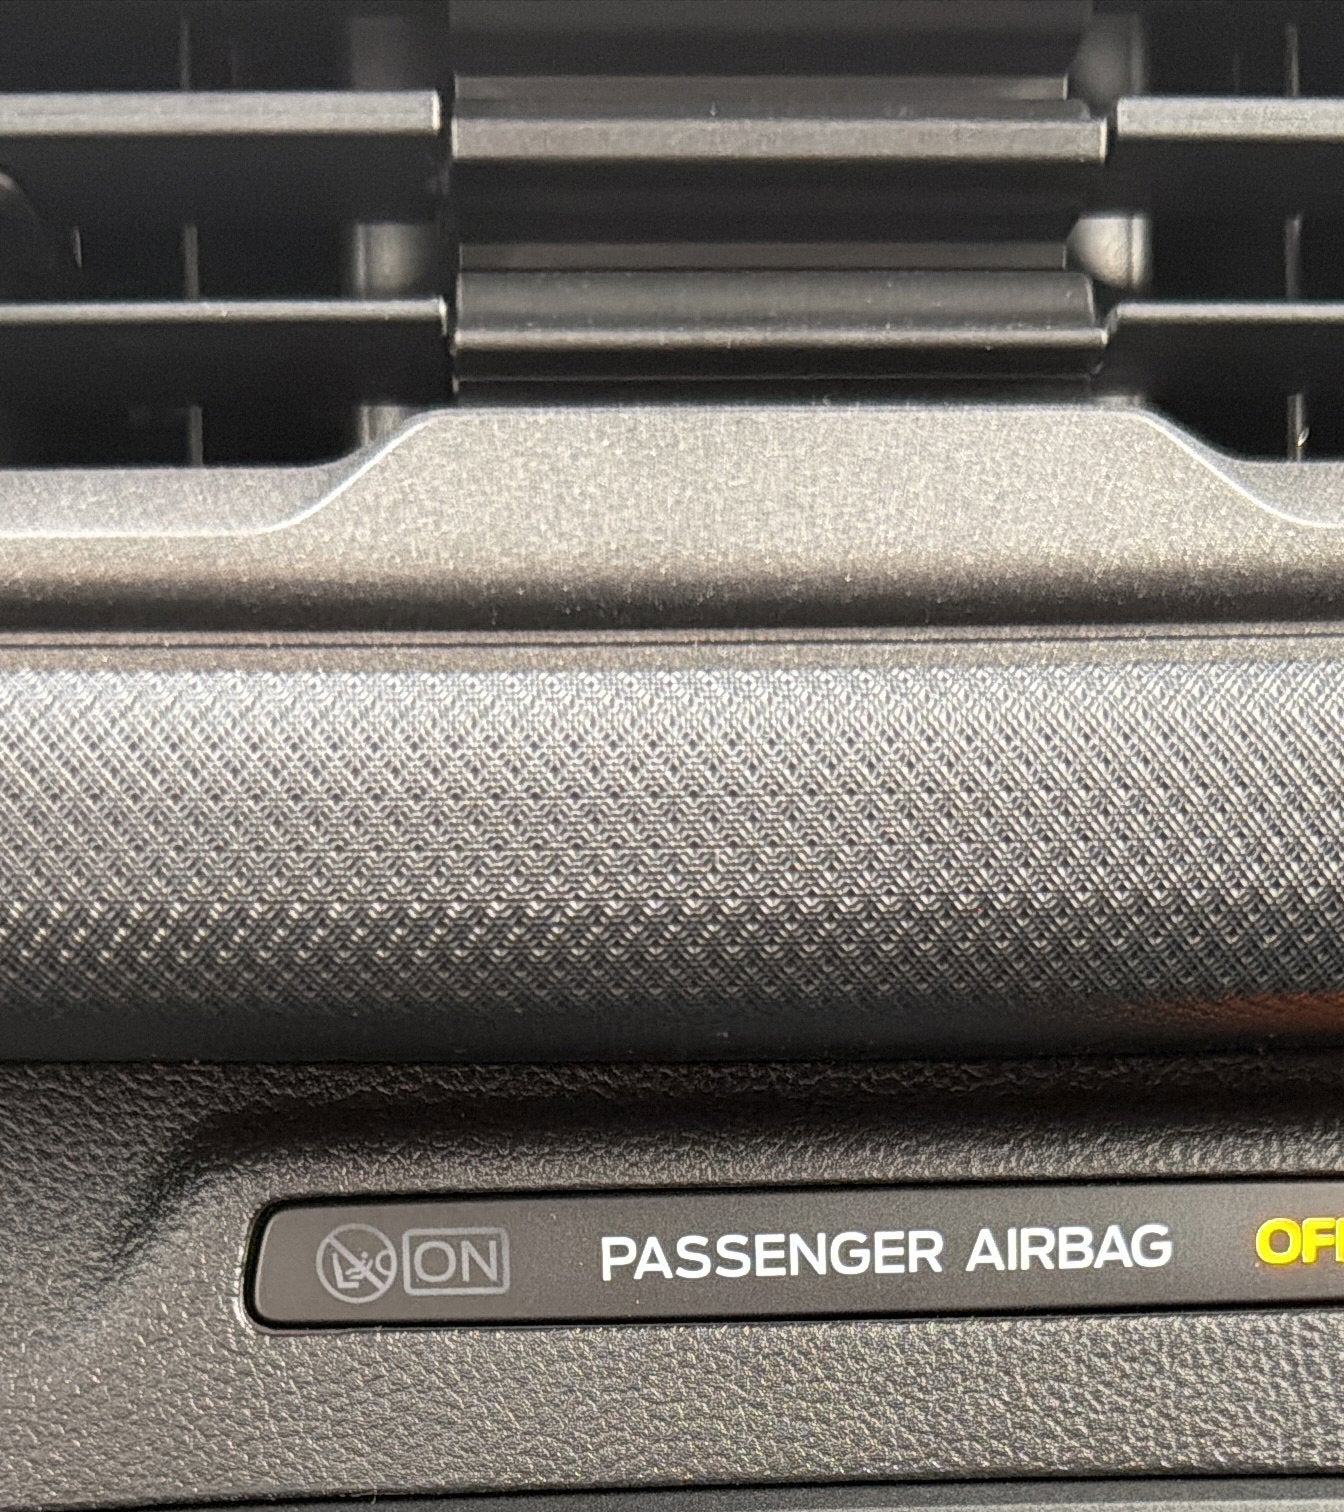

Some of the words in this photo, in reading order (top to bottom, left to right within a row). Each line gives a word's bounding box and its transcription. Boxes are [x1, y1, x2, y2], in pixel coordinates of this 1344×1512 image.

[415, 1241, 500, 1283] ON
[600, 1230, 943, 1281] PASSENGER
[965, 1223, 1173, 1271] AIRBAG
